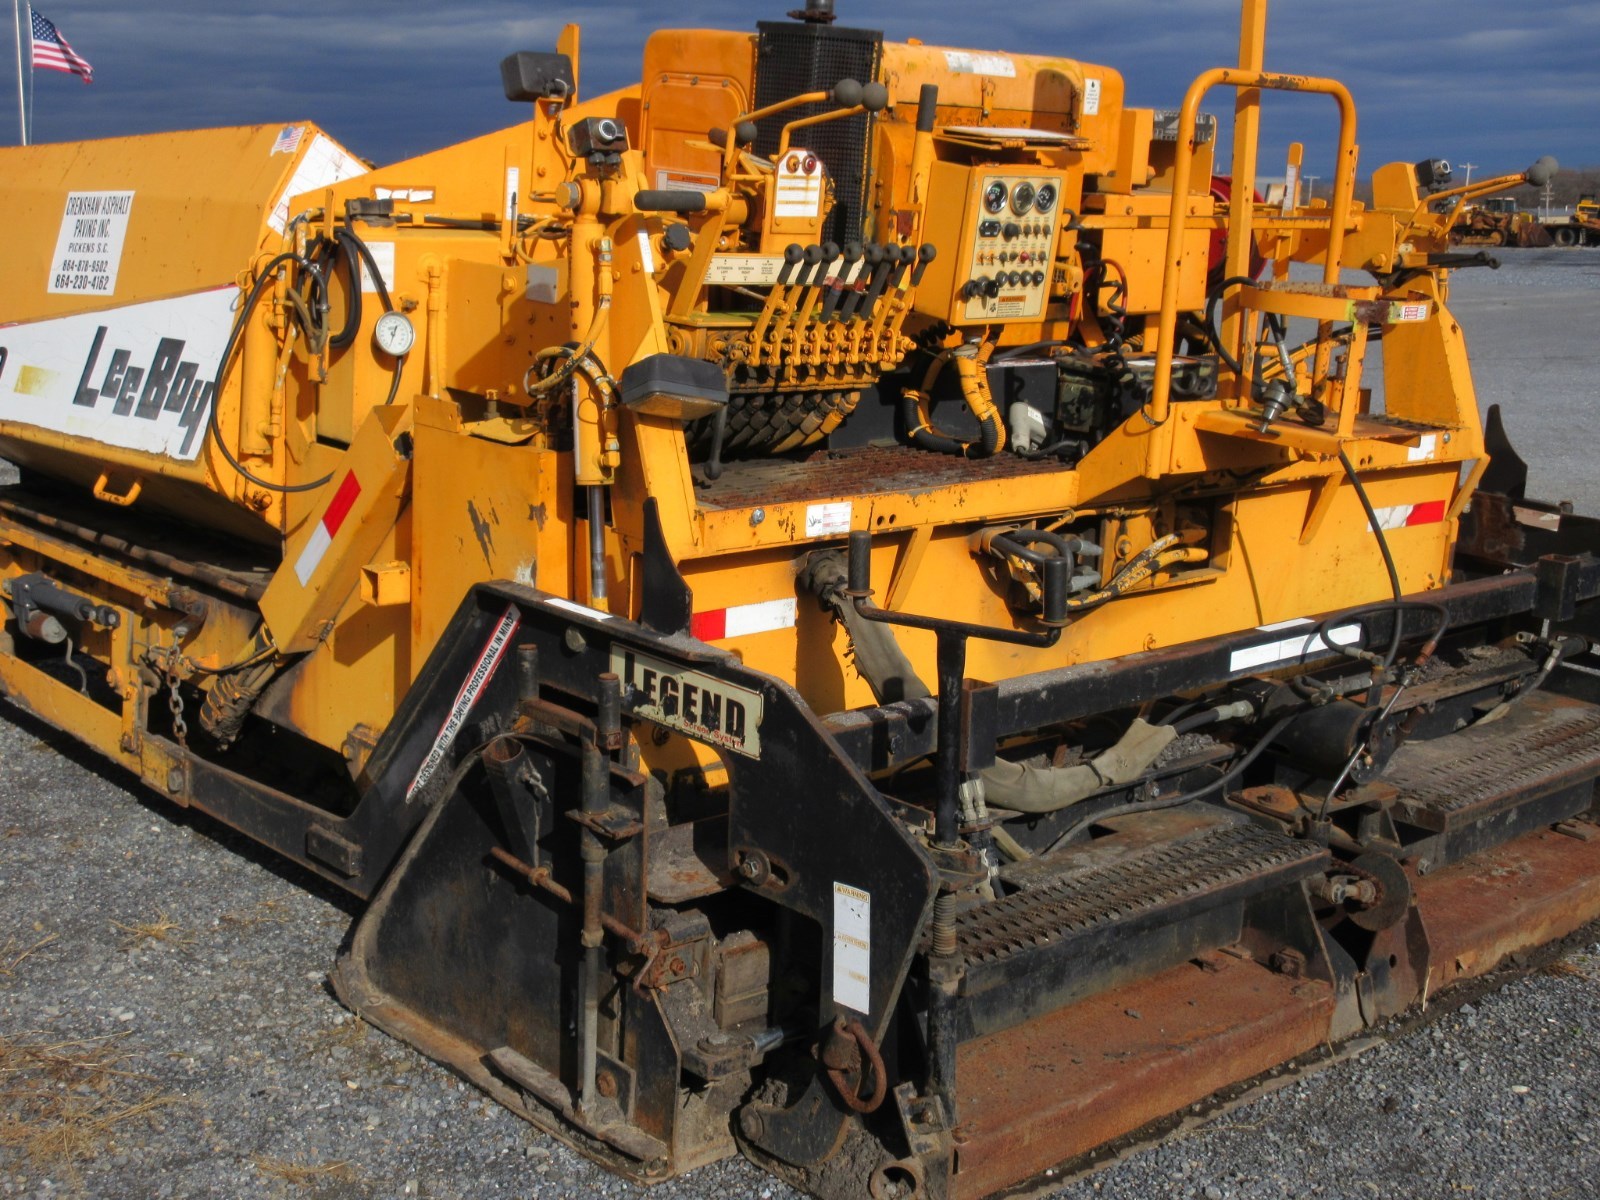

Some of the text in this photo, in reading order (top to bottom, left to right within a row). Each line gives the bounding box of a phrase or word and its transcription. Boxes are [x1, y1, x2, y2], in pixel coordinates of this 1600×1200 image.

[66, 196, 130, 215] CRENSHAW ASPHALT
[73, 218, 110, 237] PAVING INC.
[68, 242, 108, 253] PICKENS S.C.
[55, 274, 109, 289] 864-230-4162
[73, 326, 214, 455] LeeBoy
[624, 651, 746, 739] LEGEND
[419, 750, 440, 784] DESIGNED
[436, 731, 451, 752] WITH
[446, 716, 459, 735] THE
[466, 646, 500, 697] PROFESSIONAL
[494, 636, 504, 649] IN
[842, 887, 868, 901] WARNING
